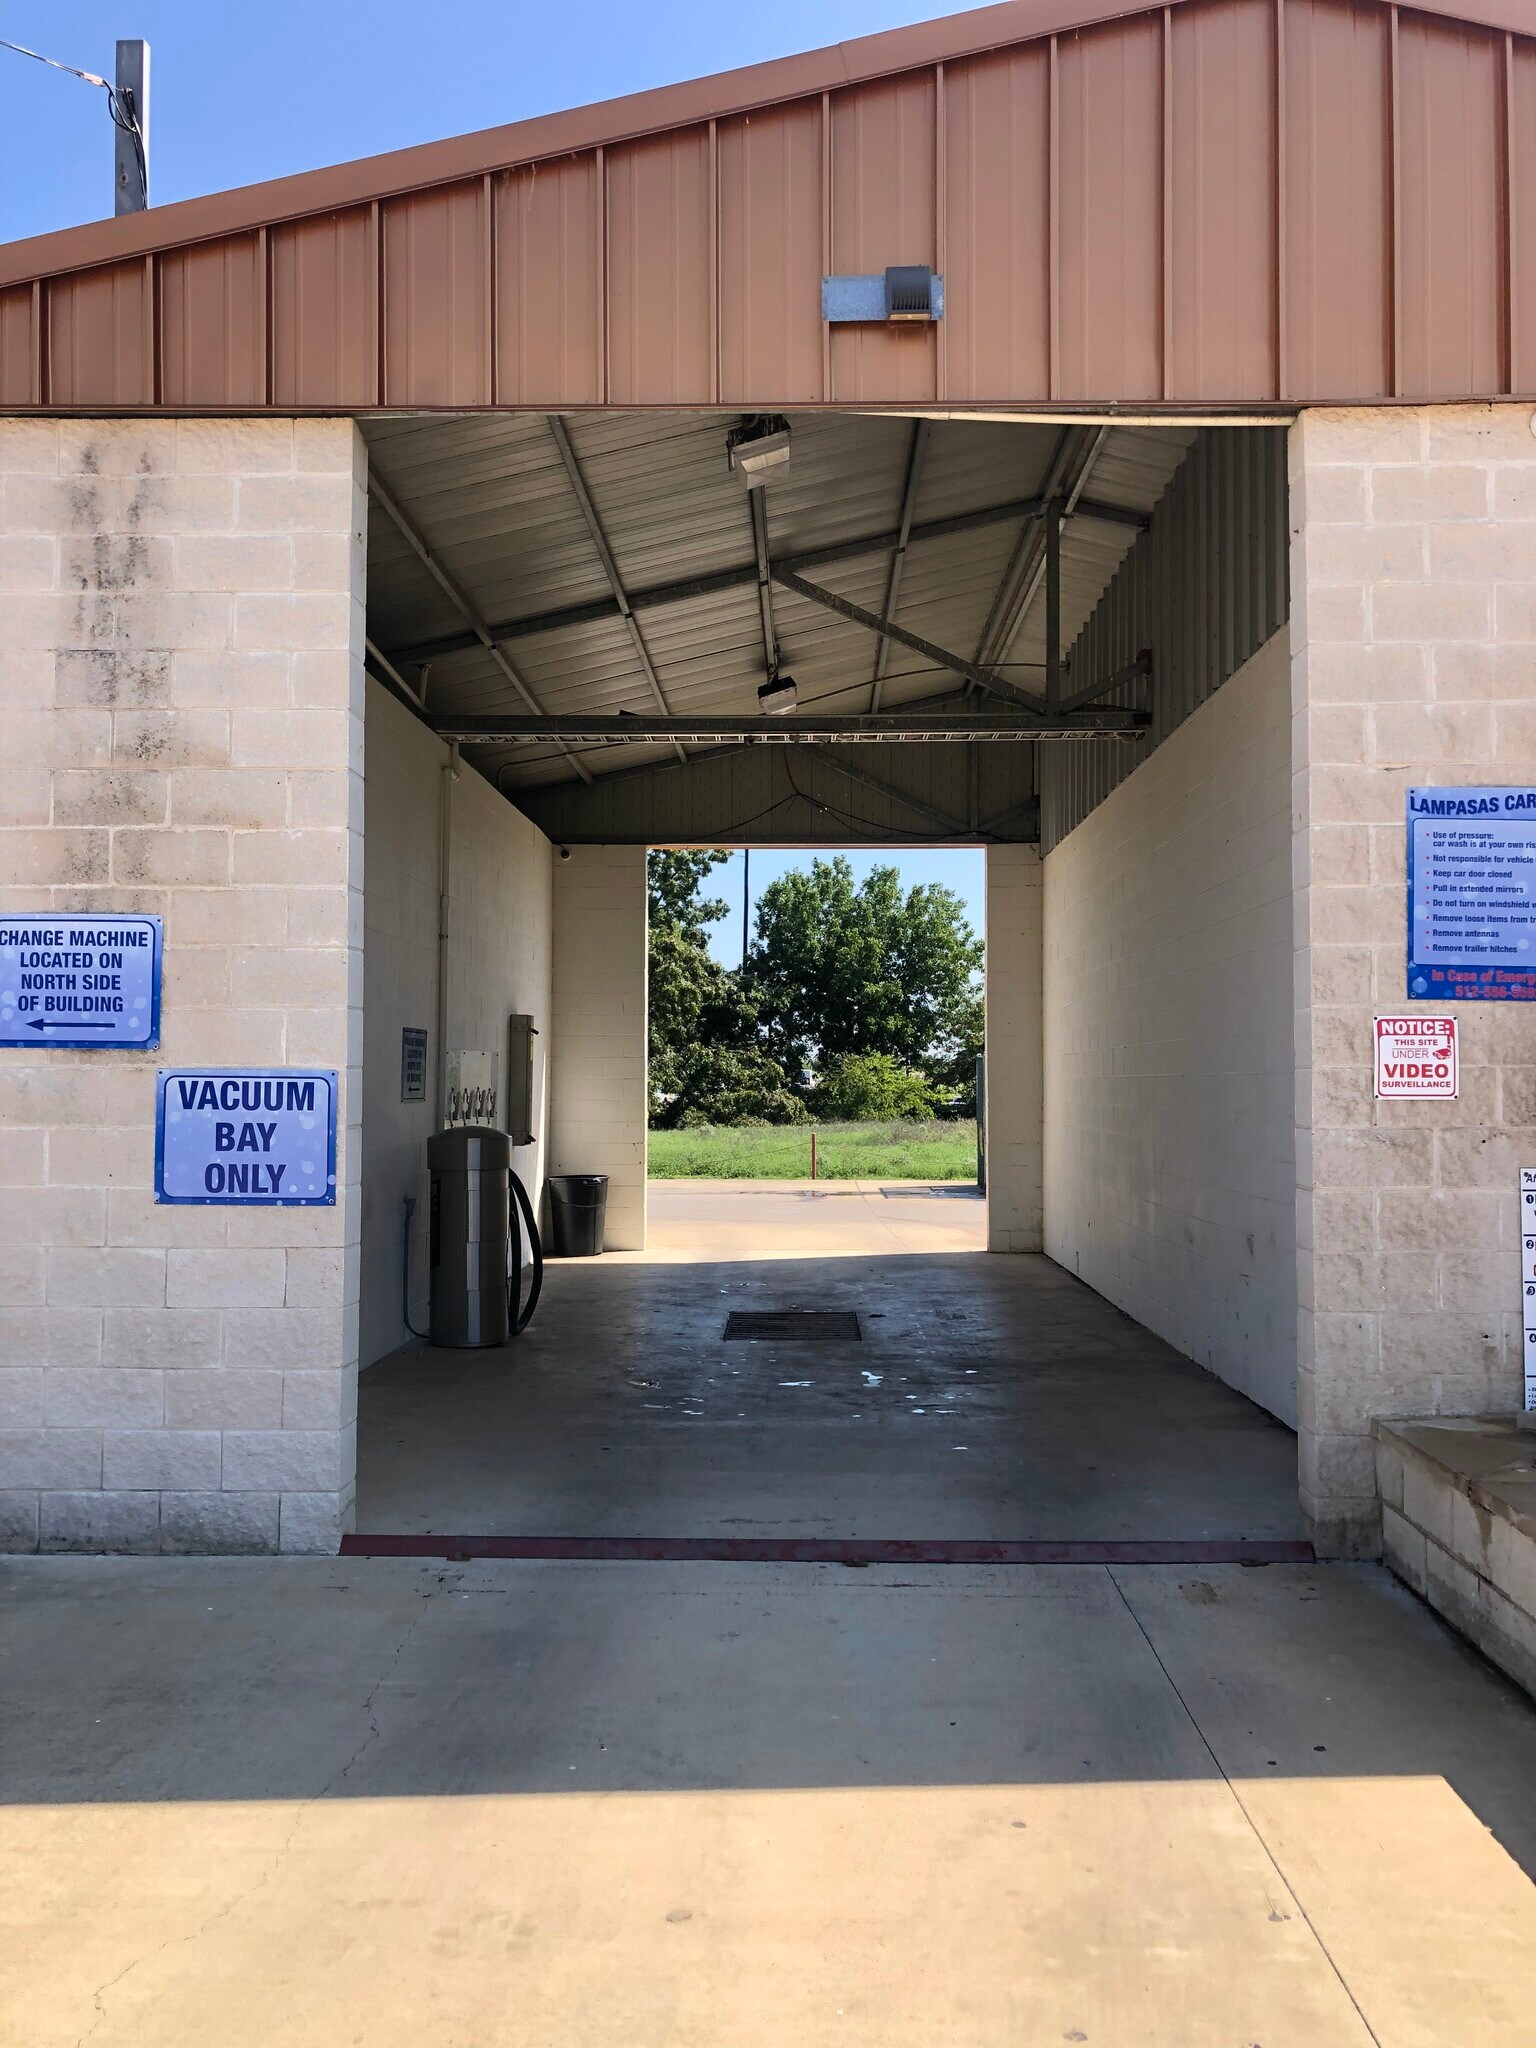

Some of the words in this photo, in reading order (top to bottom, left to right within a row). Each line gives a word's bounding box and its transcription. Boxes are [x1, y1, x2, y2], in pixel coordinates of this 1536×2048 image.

[1410, 796, 1499, 815] LAMPASAS
[1504, 793, 1536, 811] CAR
[1489, 841, 1505, 849] your
[1448, 855, 1492, 863] responsible
[1494, 855, 1504, 863] for
[1433, 869, 1451, 878] Keep
[1433, 884, 1447, 892] Pull
[1495, 885, 1524, 893] mirrors
[1433, 899, 1442, 907] Do
[1433, 914, 1462, 922] Remove
[1510, 915, 1528, 923] from
[0, 930, 63, 946] CHANGE
[70, 931, 148, 947] MACHINE
[1433, 929, 1462, 937] Remove
[1465, 930, 1500, 938] antennas
[1433, 944, 1462, 952] Remove
[1465, 944, 1488, 952] trailer
[1490, 945, 1517, 953] hitches
[20, 952, 93, 968] LOCATED
[99, 953, 122, 968] ON
[21, 974, 76, 990] NORTH
[82, 975, 121, 990] SIDE
[1432, 970, 1444, 981] In
[1447, 969, 1477, 982] Case
[1480, 970, 1494, 982] of
[1496, 970, 1536, 986] Emerg
[18, 995, 39, 1011] OF
[44, 996, 124, 1012] BUILDING
[1381, 1021, 1450, 1035] NOTICE:
[1392, 1049, 1429, 1058] UNDER
[1384, 1064, 1449, 1078] VIDEO
[178, 1080, 315, 1111] VACUUM
[215, 1122, 277, 1152] BAY
[204, 1163, 287, 1194] ONLY
